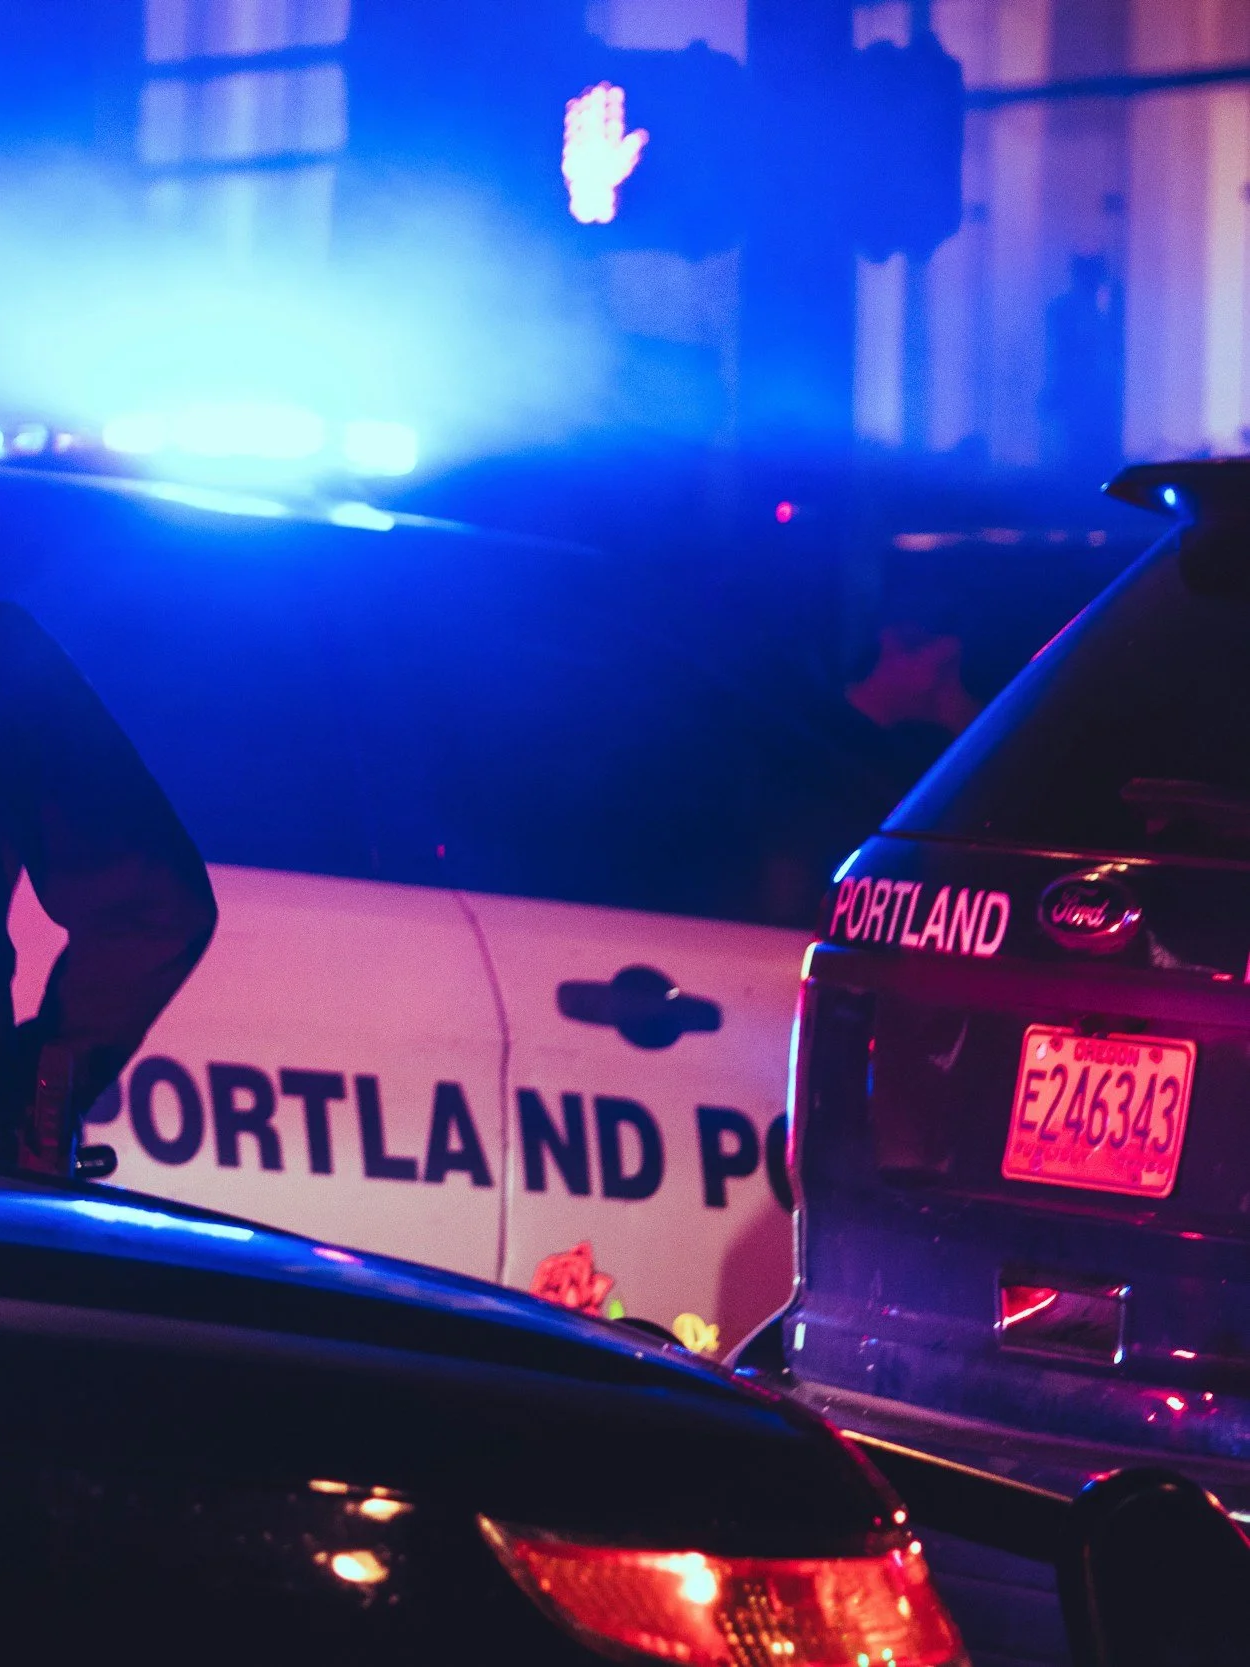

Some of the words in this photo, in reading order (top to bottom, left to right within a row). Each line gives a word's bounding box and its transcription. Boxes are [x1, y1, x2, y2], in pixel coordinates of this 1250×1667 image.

[829, 876, 1011, 957] PORTLAND
[1052, 892, 1109, 928] Ford
[1074, 1040, 1140, 1068] OREGON
[1019, 1064, 1181, 1153] E246343
